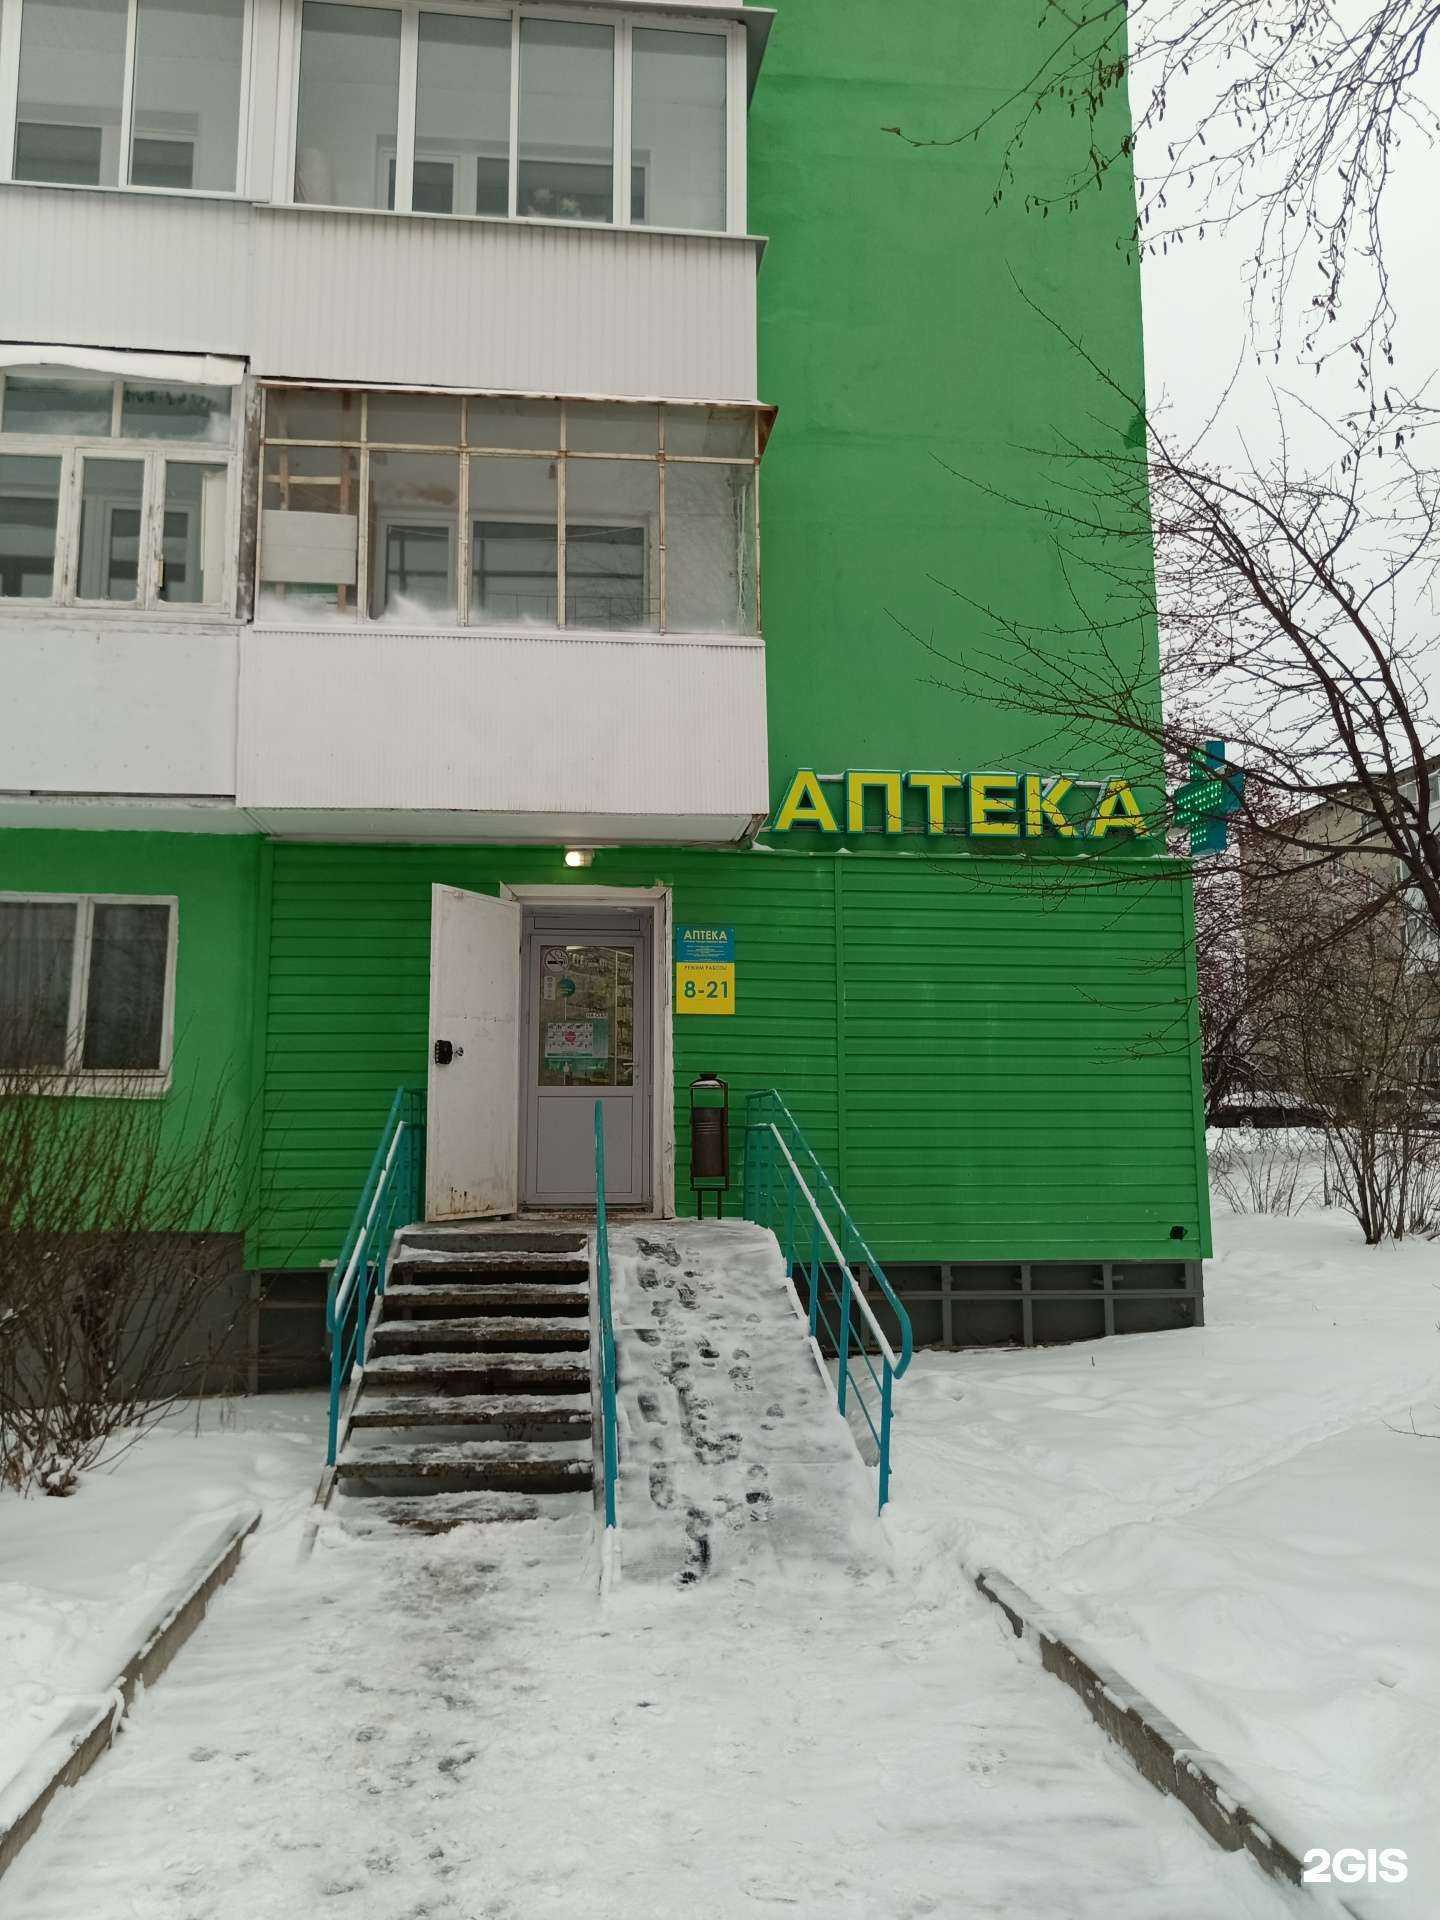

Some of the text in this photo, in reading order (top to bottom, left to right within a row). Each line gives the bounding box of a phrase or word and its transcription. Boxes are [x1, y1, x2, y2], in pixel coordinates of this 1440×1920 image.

[770, 768, 1150, 838] АПТЕКА
[683, 930, 728, 940] АПТЕКА
[684, 980, 728, 999] 8-21
